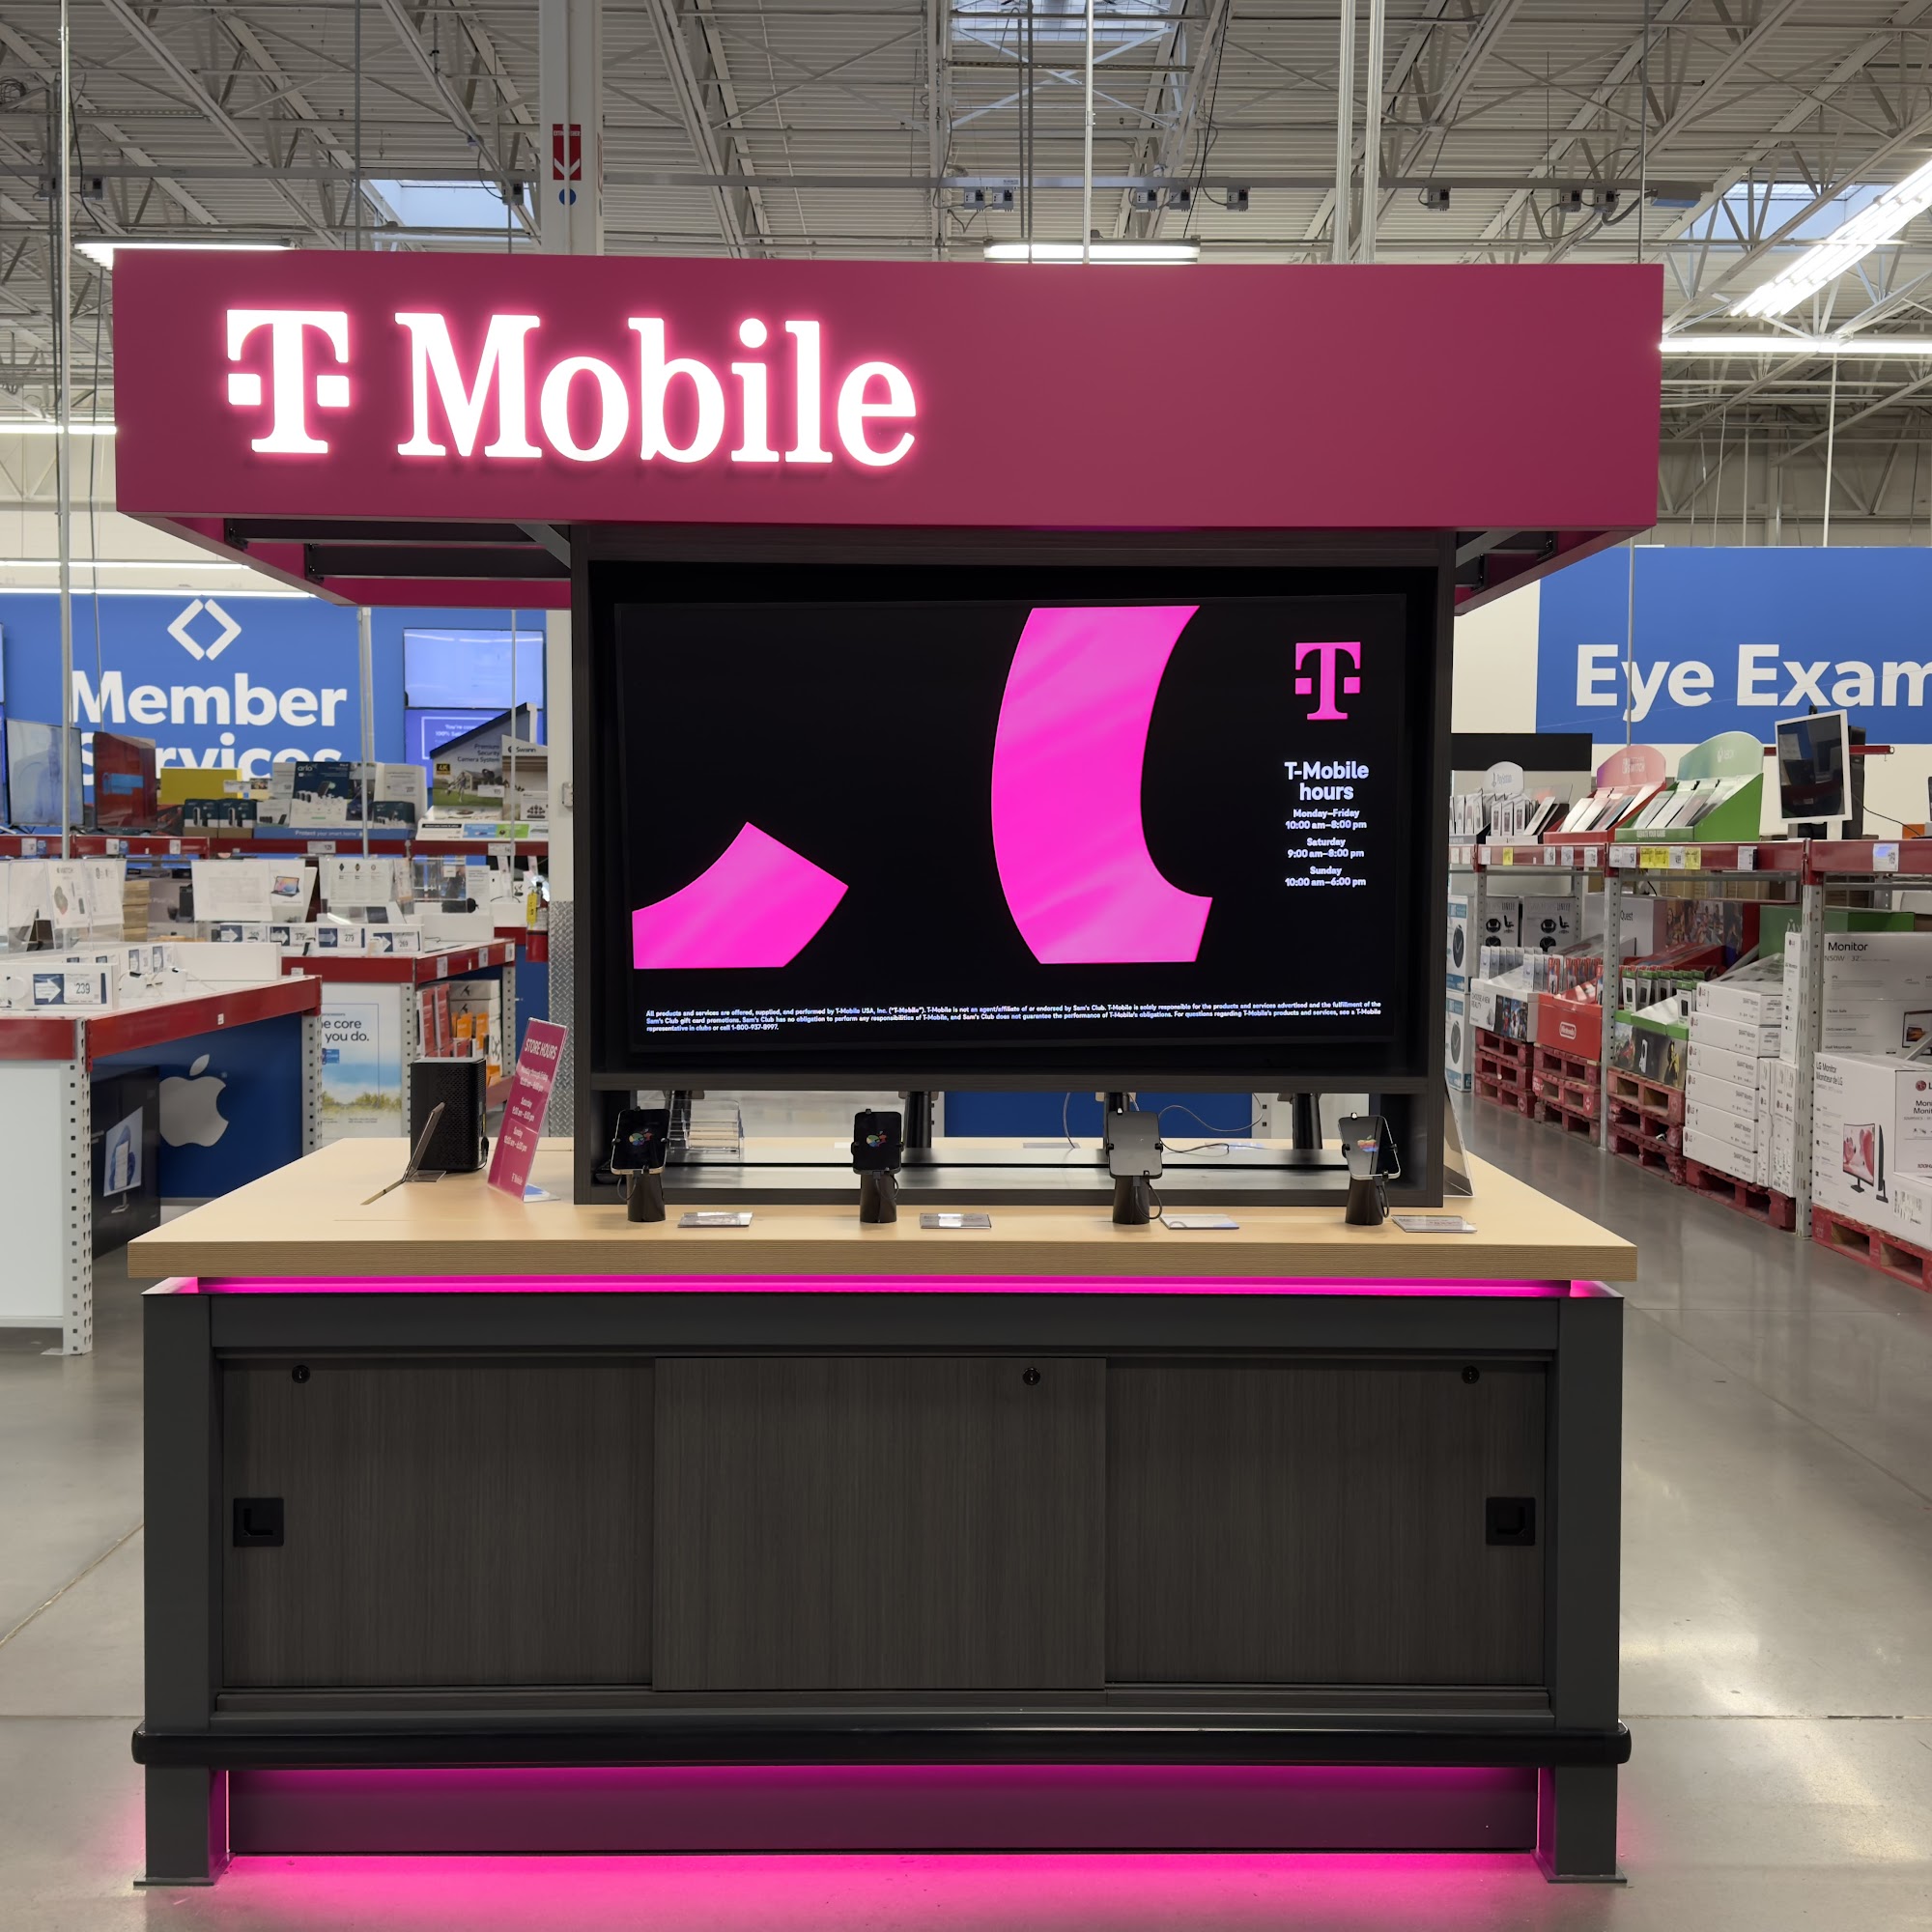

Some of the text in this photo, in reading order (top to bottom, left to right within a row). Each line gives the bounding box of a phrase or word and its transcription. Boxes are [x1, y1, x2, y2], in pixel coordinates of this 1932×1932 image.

[226, 309, 918, 469] T Mobile
[1576, 643, 1932, 723] Eye Exam
[71, 670, 347, 727] Member
[1284, 761, 1369, 780] T-Mobile
[1299, 782, 1354, 801] hours
[1286, 821, 1310, 830] 10:00
[1352, 822, 1367, 831] pm
[1306, 838, 1346, 848] Saturday
[1288, 849, 1308, 858] 9:00
[1350, 850, 1364, 860] pm
[1310, 867, 1342, 876] Sunday
[1285, 878, 1310, 887] 10:00
[1352, 879, 1367, 888] pm
[1828, 942, 1868, 952] Monitor
[75, 982, 91, 994] 239
[333, 1020, 361, 1029] core
[326, 1032, 370, 1043] you do.
[525, 1038, 557, 1060] STORE HOURS
[1822, 1063, 1837, 1073] Monitor
